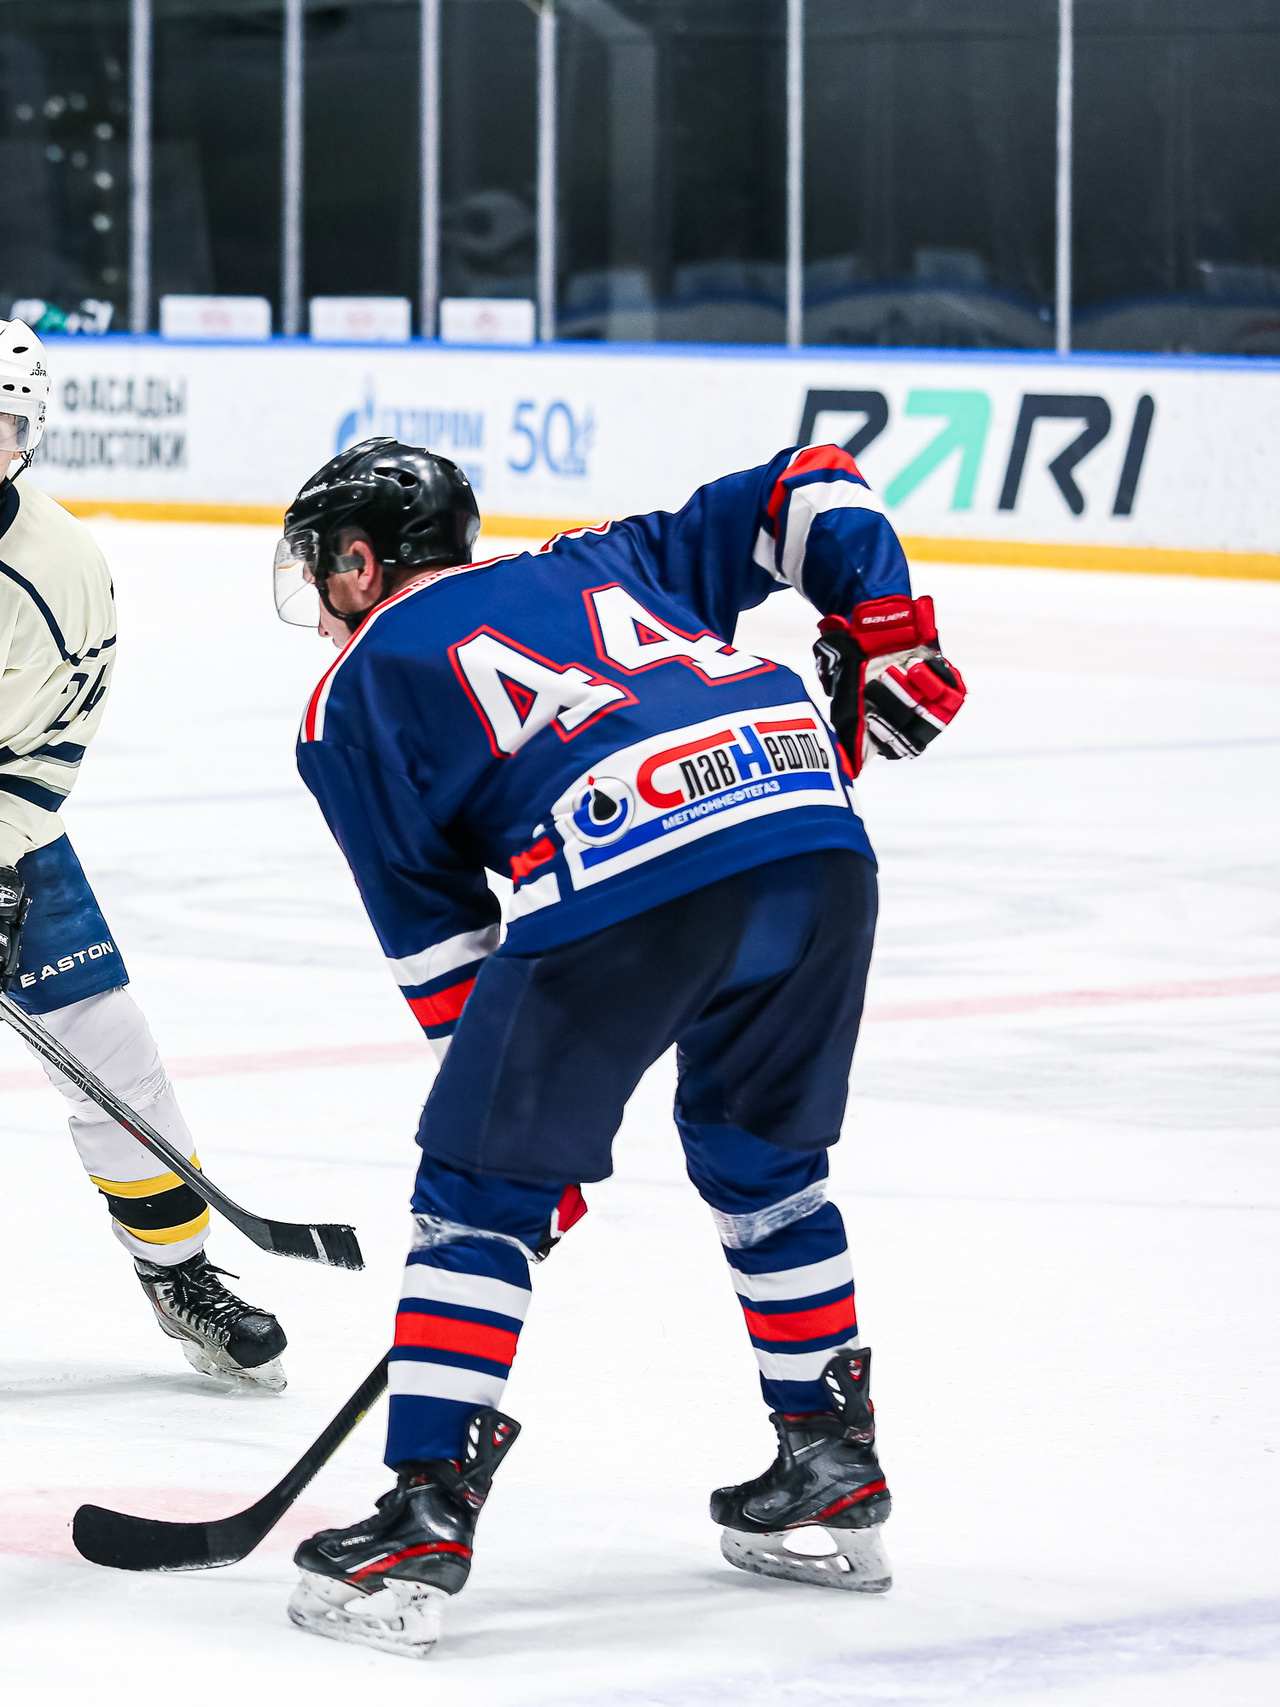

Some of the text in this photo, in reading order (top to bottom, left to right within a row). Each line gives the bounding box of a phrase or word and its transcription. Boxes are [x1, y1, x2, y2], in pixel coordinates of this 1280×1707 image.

[862, 611, 909, 624] BAUER
[447, 581, 777, 759] 44
[662, 780, 781, 831] МЕГИОННЕФТЕГАЗ
[20, 940, 115, 988] EASTON
